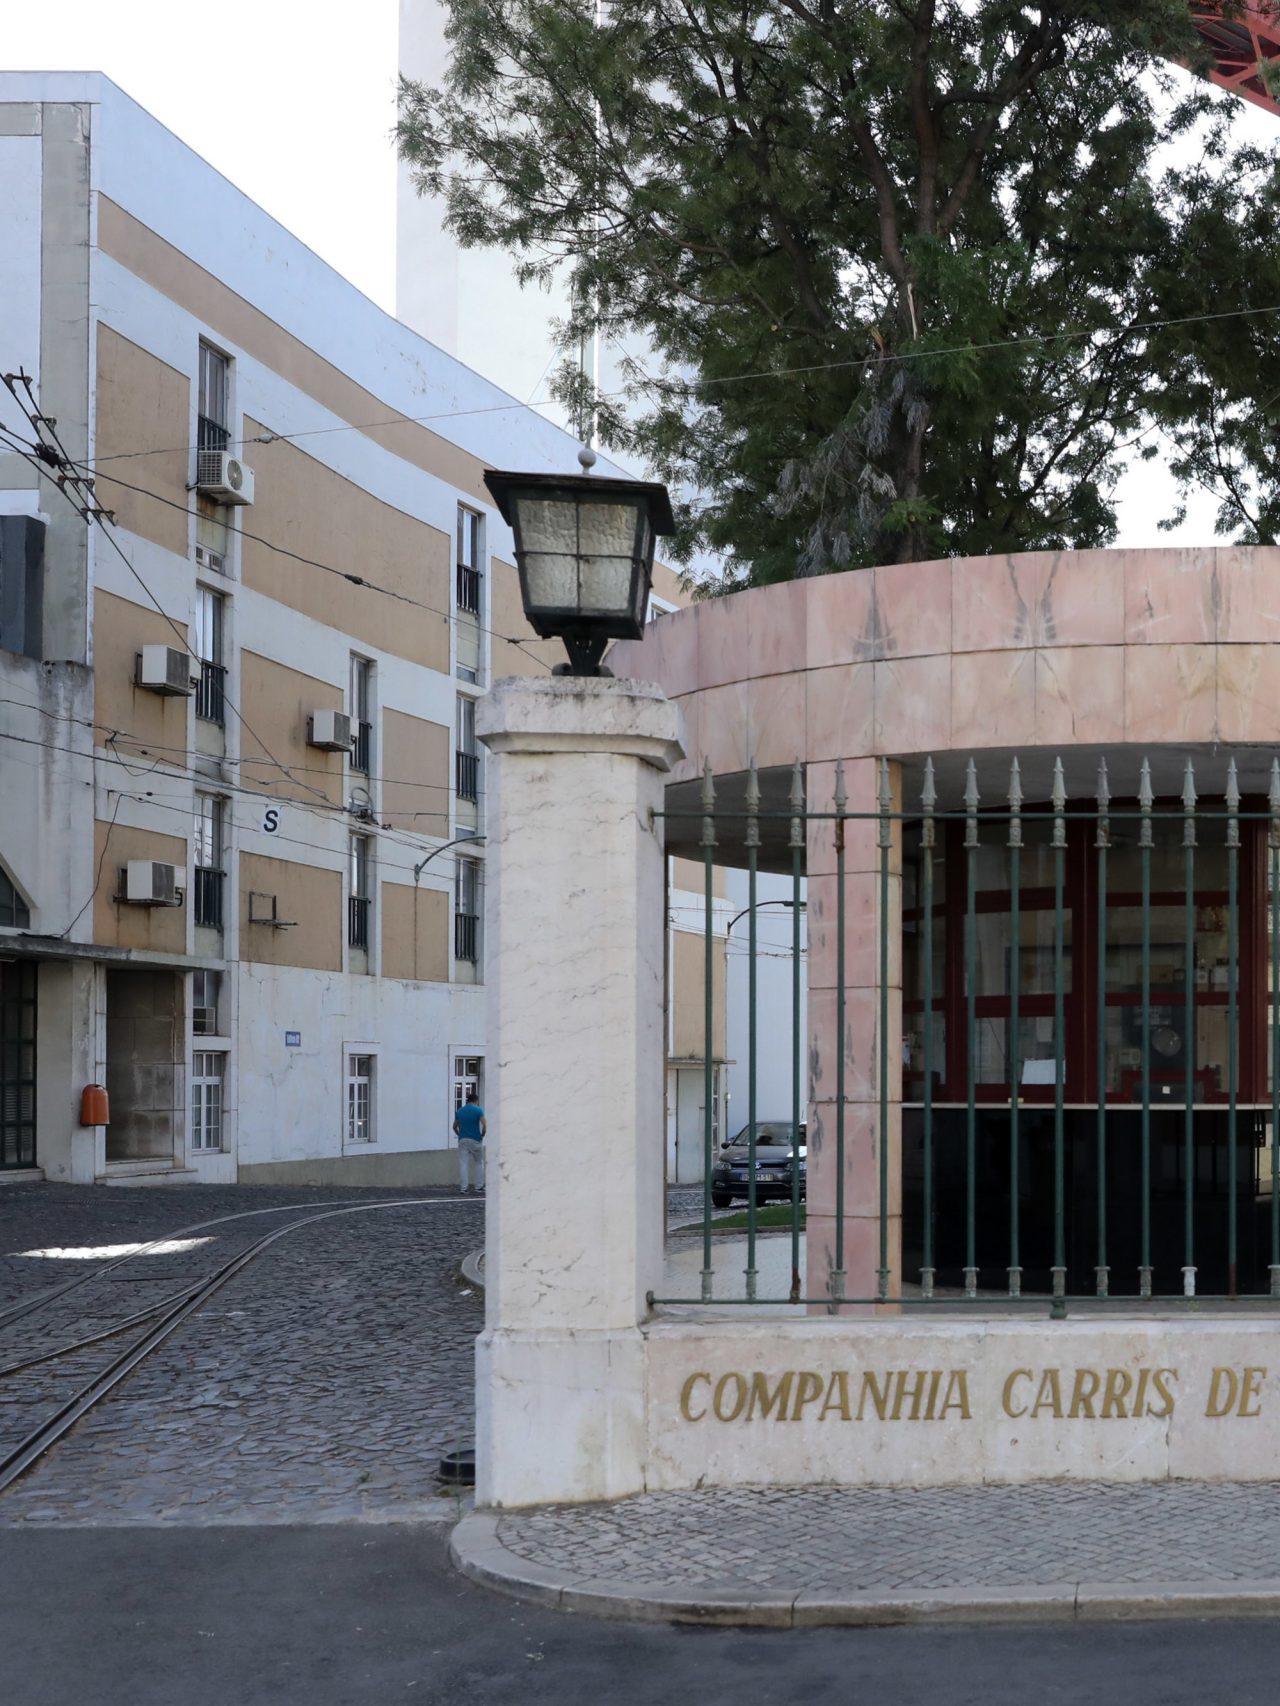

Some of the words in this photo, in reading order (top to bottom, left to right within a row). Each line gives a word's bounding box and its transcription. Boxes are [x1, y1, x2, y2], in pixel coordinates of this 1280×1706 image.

[263, 809, 279, 833] S
[680, 1370, 972, 1422] COMPANHIA
[1001, 1367, 1179, 1419] CARRIS
[1204, 1366, 1267, 1417] DE
